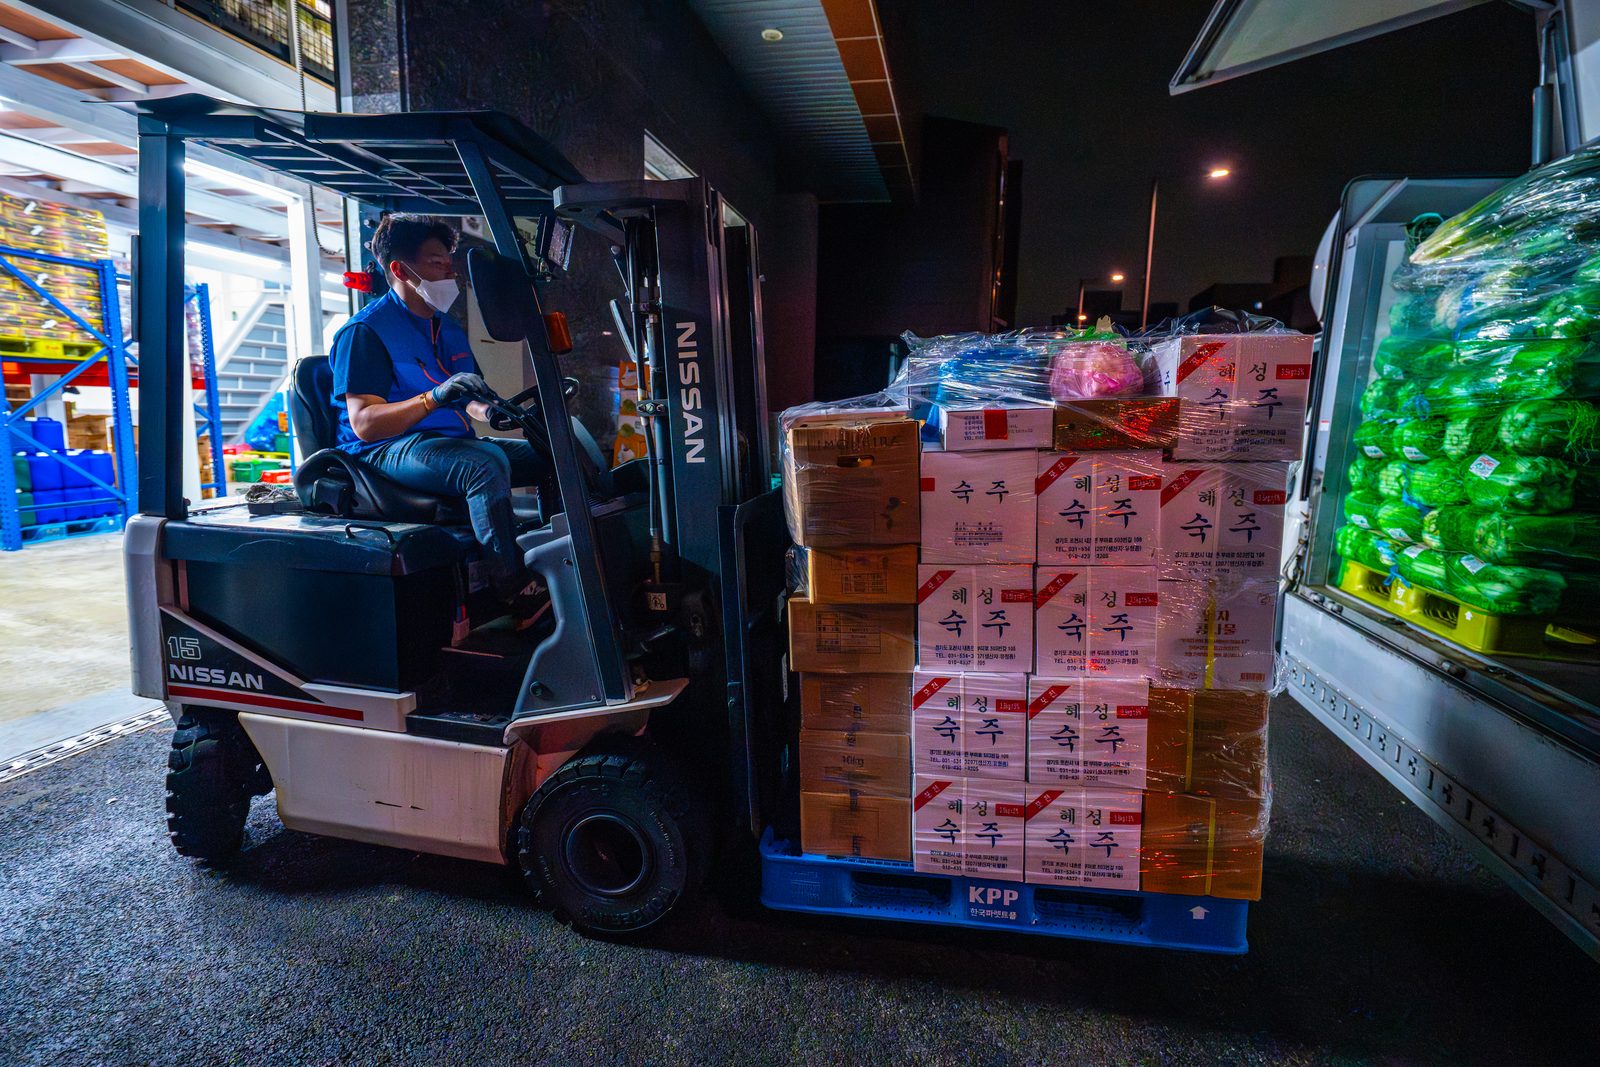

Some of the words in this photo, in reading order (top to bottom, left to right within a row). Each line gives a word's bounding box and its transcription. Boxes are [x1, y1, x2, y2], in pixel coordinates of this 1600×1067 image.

[676, 322, 705, 464] NISSAN
[950, 480, 1009, 504] 숙주
[1058, 498, 1137, 530] 숙주
[1180, 512, 1261, 544] 숙주
[938, 609, 1011, 639] 숙주
[1057, 612, 1134, 643] 숙주
[168, 636, 202, 660] 15
[169, 664, 264, 690] NISSAN
[932, 715, 1004, 746] 숙주
[1050, 724, 1125, 754] 숙주
[933, 818, 1003, 848] 숙주
[1045, 828, 1119, 858] 숙주
[969, 886, 1019, 906] KPP
